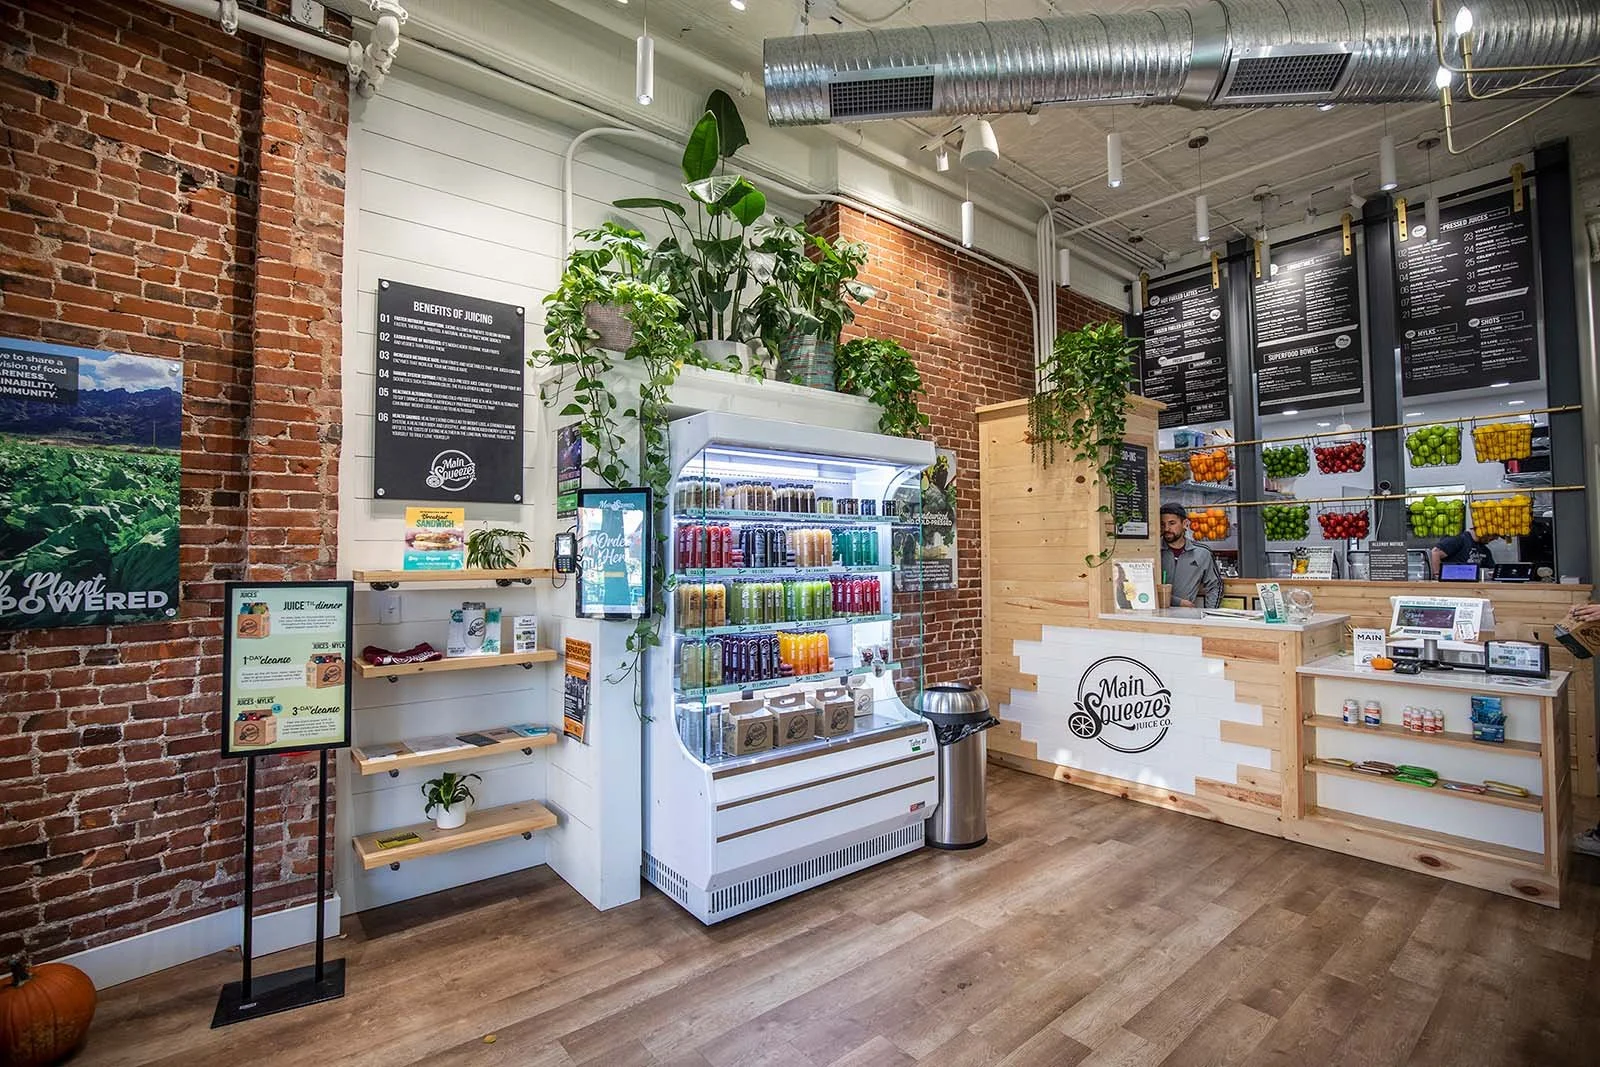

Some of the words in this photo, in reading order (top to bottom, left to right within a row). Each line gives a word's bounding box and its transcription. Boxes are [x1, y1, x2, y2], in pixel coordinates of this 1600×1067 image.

[1464, 232, 1474, 242] 23
[1464, 245, 1474, 255] 24
[1464, 258, 1476, 268] 25
[1466, 271, 1475, 280] 31
[1466, 284, 1477, 294] 32
[380, 313, 391, 323] 01
[413, 300, 452, 318] BENEFITS
[452, 308, 464, 320] OF
[464, 310, 493, 325] JUICING
[1480, 316, 1500, 326] SHOTS
[379, 332, 391, 343] 02
[379, 350, 390, 361] 03
[1300, 346, 1319, 356] BOWLS
[13, 353, 24, 361] to
[26, 355, 55, 365] share
[56, 359, 64, 367] a
[0, 368, 47, 382] RENESS.
[30, 364, 42, 372] of
[43, 365, 67, 375] food
[378, 368, 390, 379] 04
[378, 387, 389, 397] 05
[378, 412, 389, 422] 06
[442, 458, 465, 469] Main
[434, 465, 475, 482] Squeeze
[416, 520, 455, 528] SANDWICH
[596, 532, 631, 550] Orde
[601, 548, 627, 566] Her
[23, 571, 107, 597] Plant
[283, 601, 305, 611] JUICE
[315, 600, 343, 610] dinner
[260, 655, 292, 665] cleanse
[1099, 675, 1145, 699] Main
[311, 705, 341, 715] cleanse
[1084, 692, 1171, 735] Squeeze
[1136, 720, 1159, 731] JUICE
[1160, 718, 1173, 727] CO.
